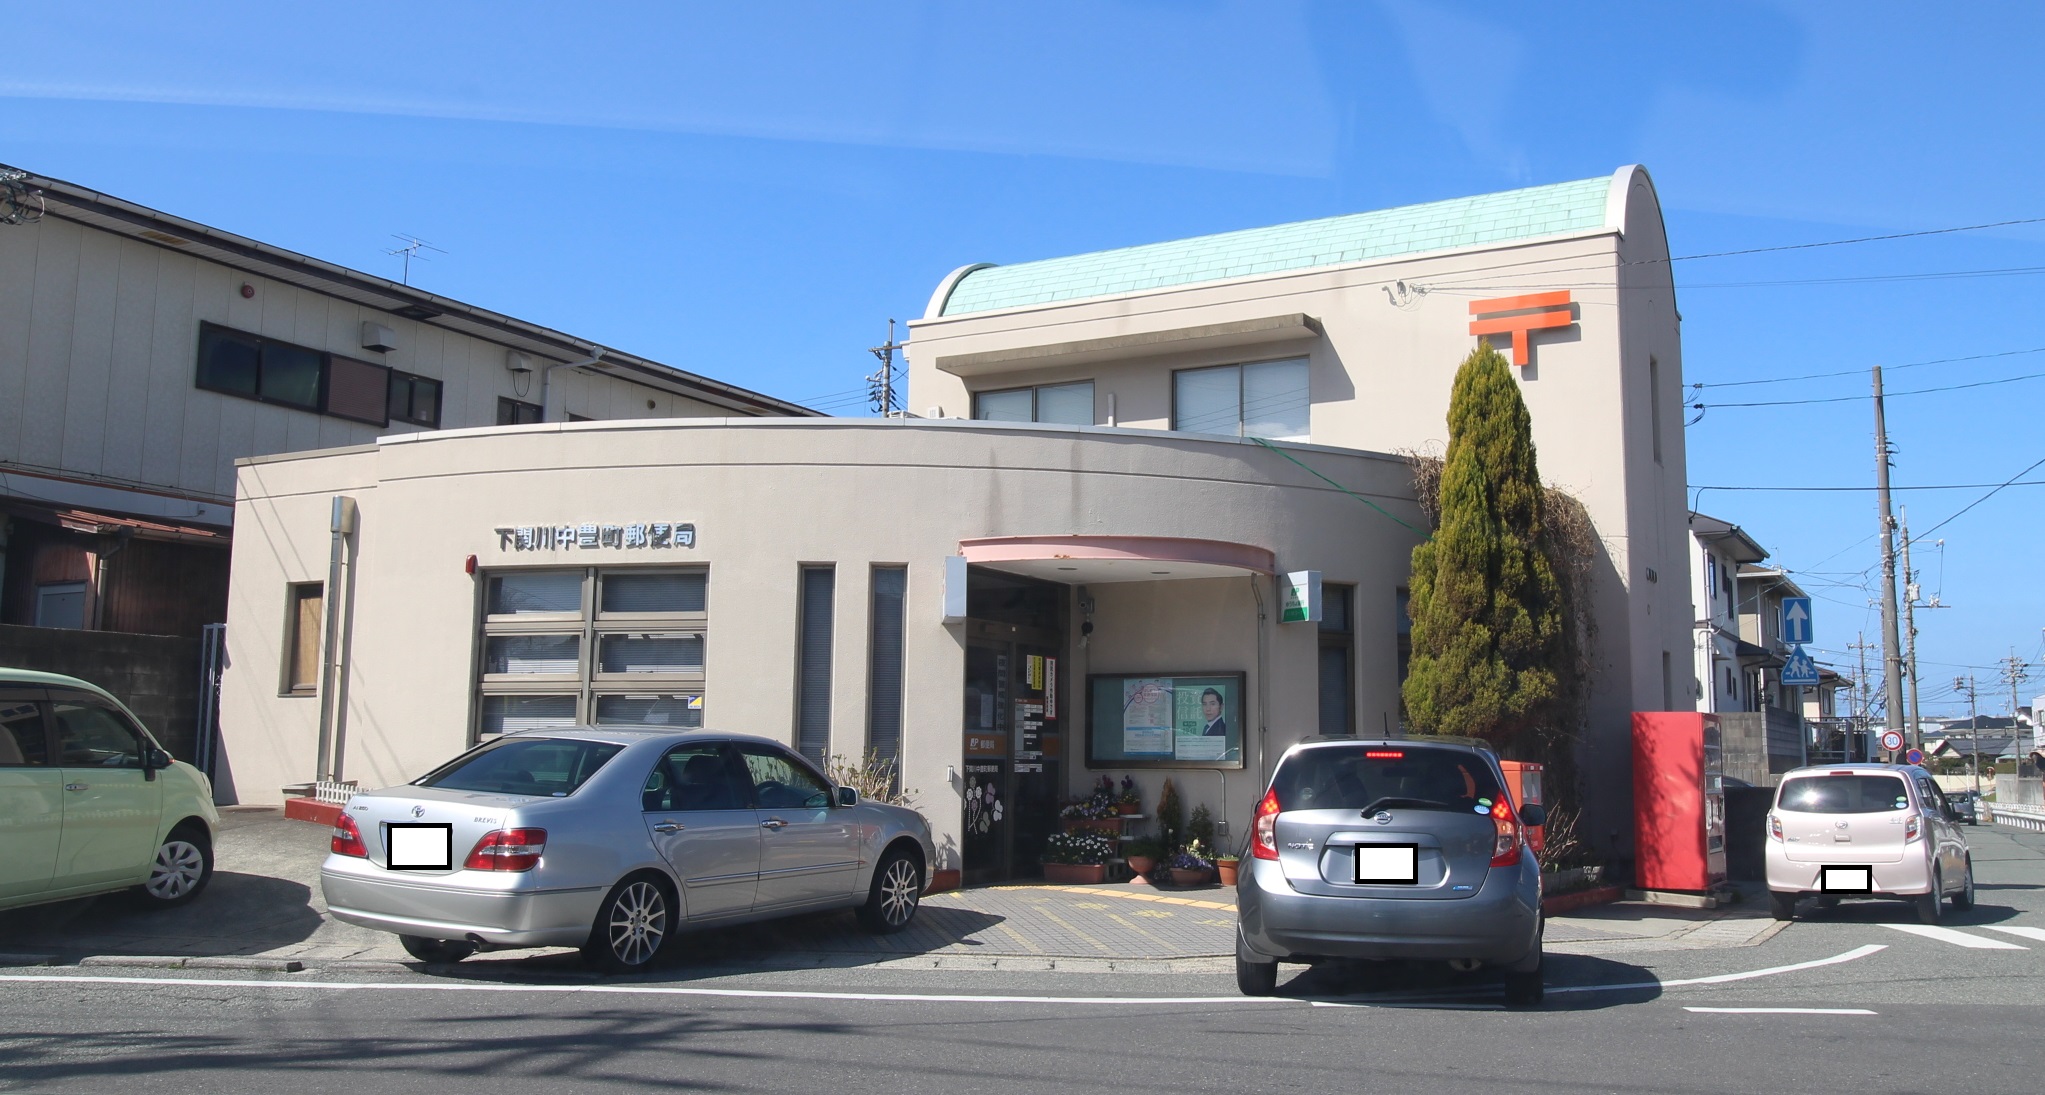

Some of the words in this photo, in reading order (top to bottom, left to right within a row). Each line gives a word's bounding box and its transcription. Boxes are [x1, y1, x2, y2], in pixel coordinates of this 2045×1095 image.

[494, 523, 696, 550] 下関川中豊町郵便局
[1886, 736, 1899, 745] 30
[473, 816, 497, 824] BREVIS
